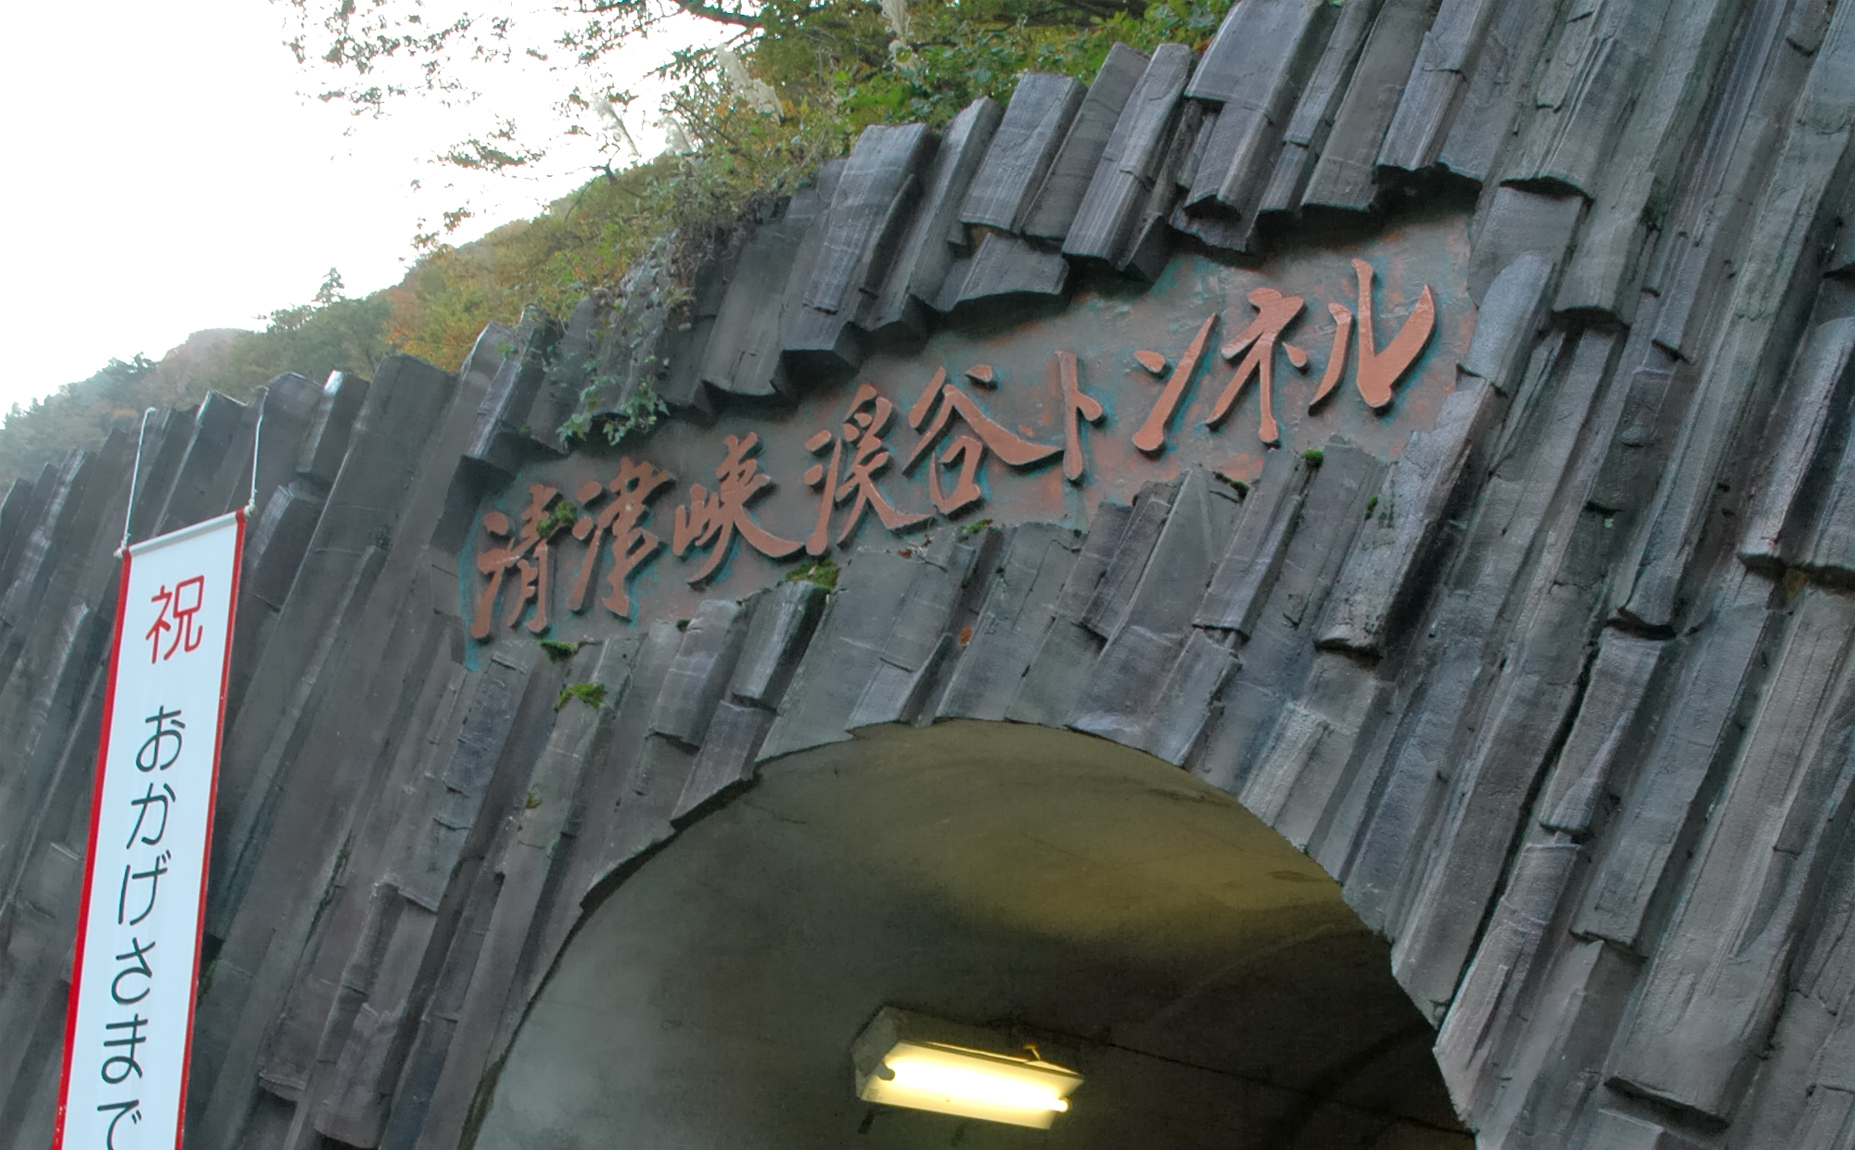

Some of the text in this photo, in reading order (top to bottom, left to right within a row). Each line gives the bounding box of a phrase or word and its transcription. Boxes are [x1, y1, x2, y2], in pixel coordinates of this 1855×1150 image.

[471, 257, 1437, 640] 清津峡渓谷トンネル
[145, 574, 205, 665] 祝
